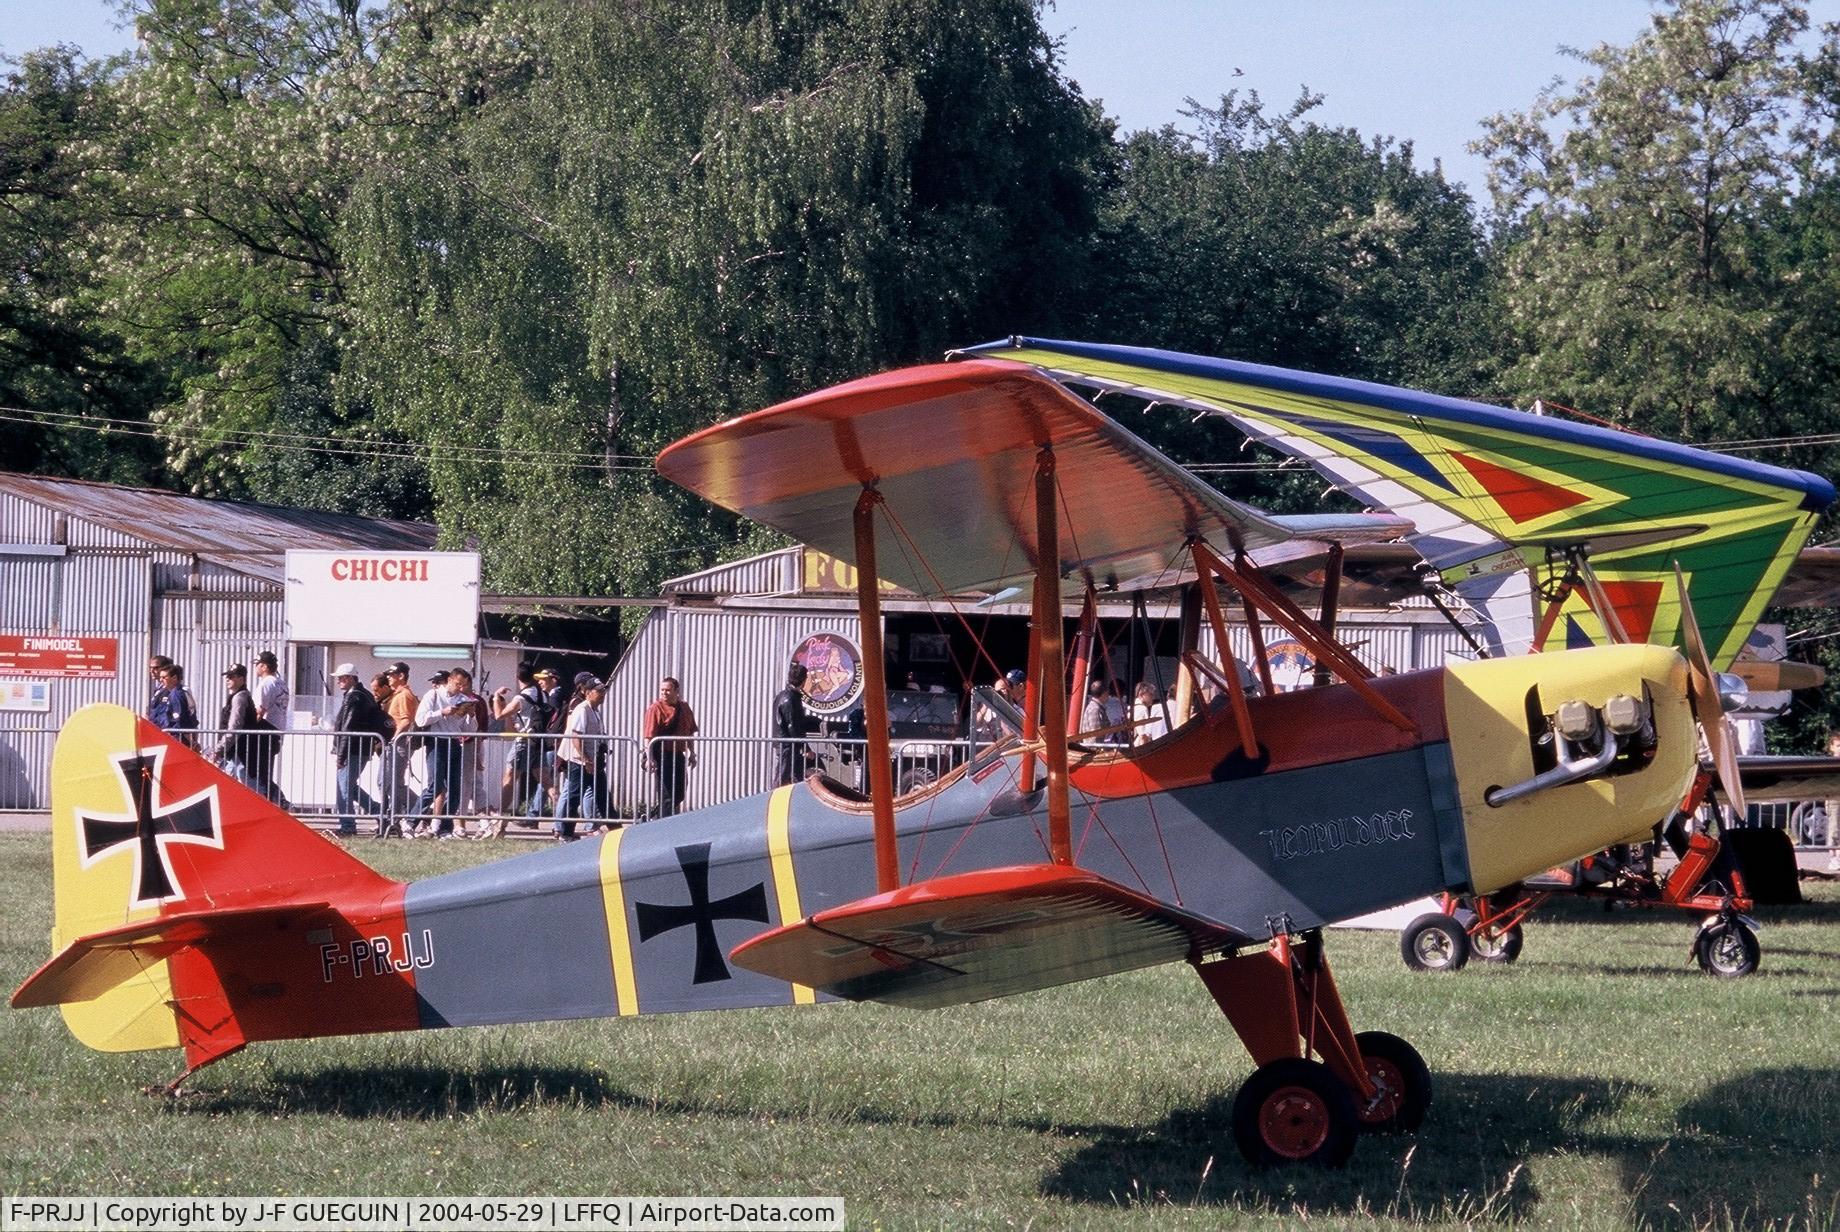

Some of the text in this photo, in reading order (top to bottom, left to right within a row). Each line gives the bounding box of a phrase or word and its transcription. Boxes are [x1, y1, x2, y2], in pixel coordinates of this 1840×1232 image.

[331, 559, 429, 582] CHICHI
[23, 638, 84, 652] FINIMODEL
[320, 929, 435, 983] F-PRJJ
